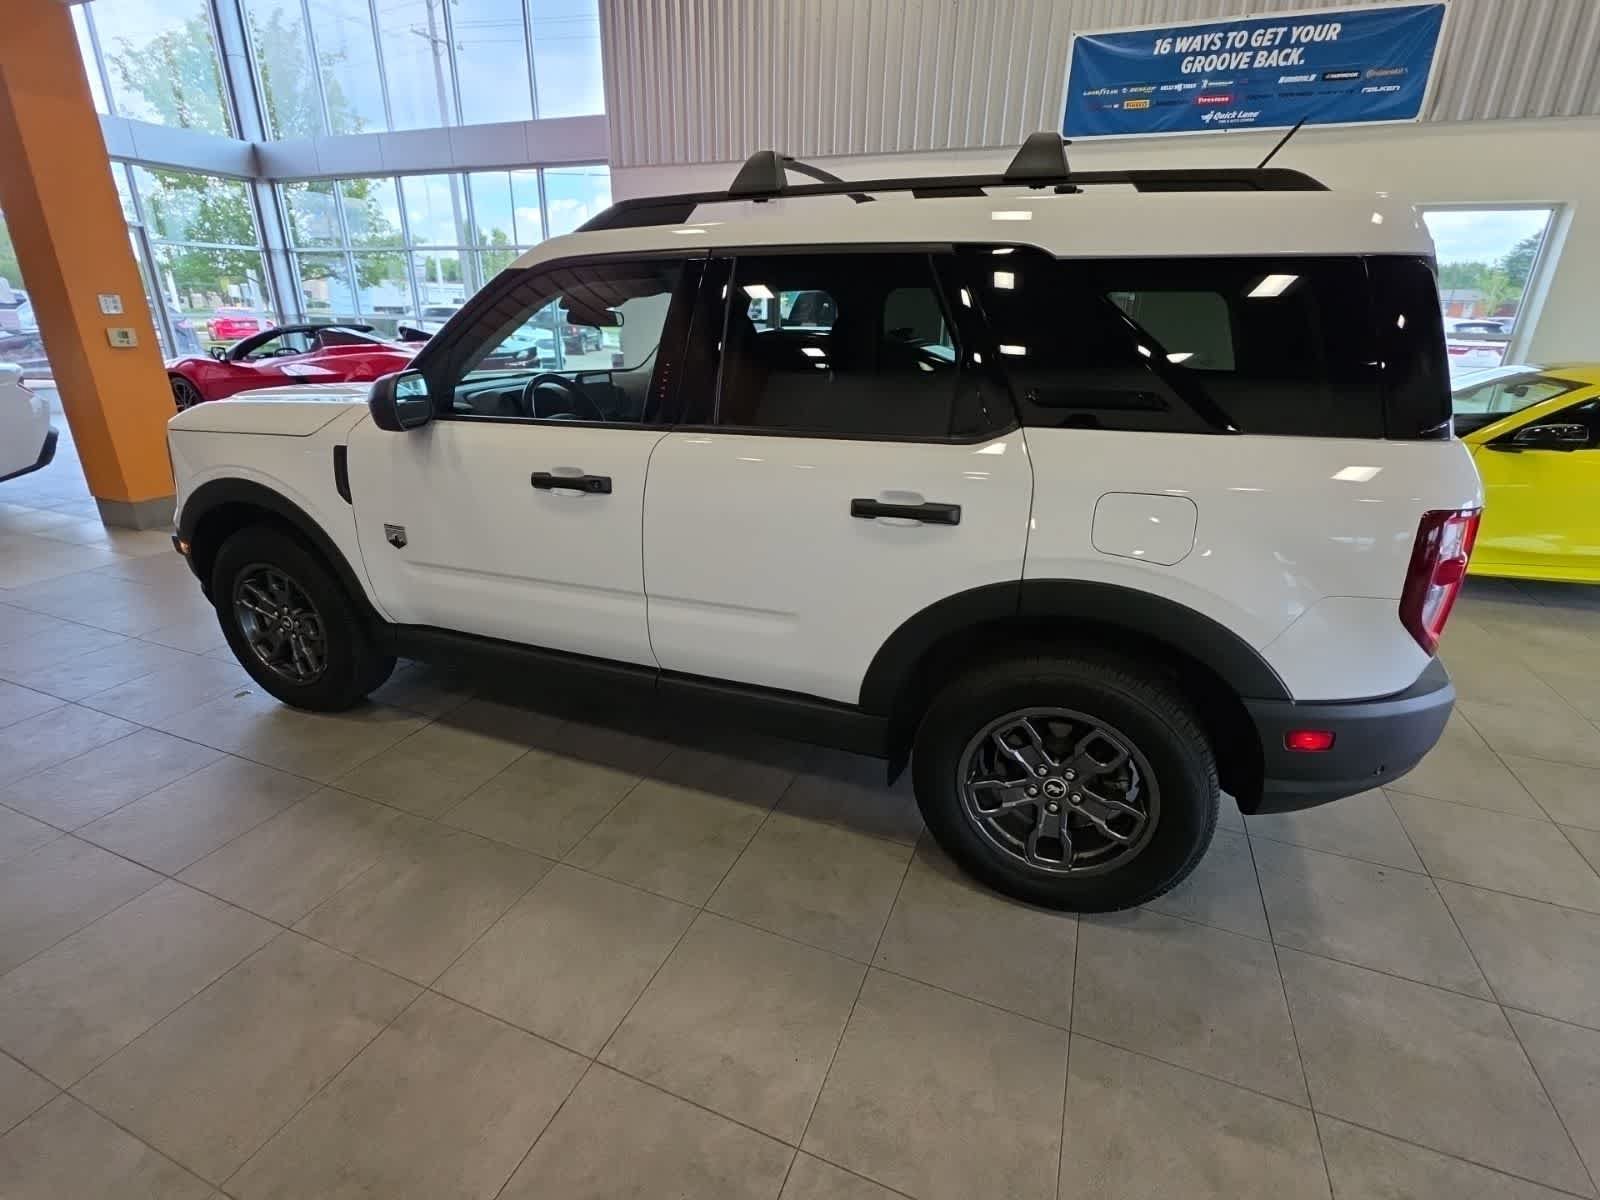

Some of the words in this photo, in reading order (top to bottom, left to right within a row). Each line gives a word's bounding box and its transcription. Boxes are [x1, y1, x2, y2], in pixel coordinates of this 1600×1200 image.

[1153, 38, 1172, 55] 16
[1174, 32, 1223, 53] WAYS
[1226, 30, 1249, 49] TO
[1251, 27, 1287, 47] GET
[1290, 23, 1342, 43] YOUR
[1181, 51, 1253, 74] GROOVE
[1253, 47, 1305, 68] BACK.
